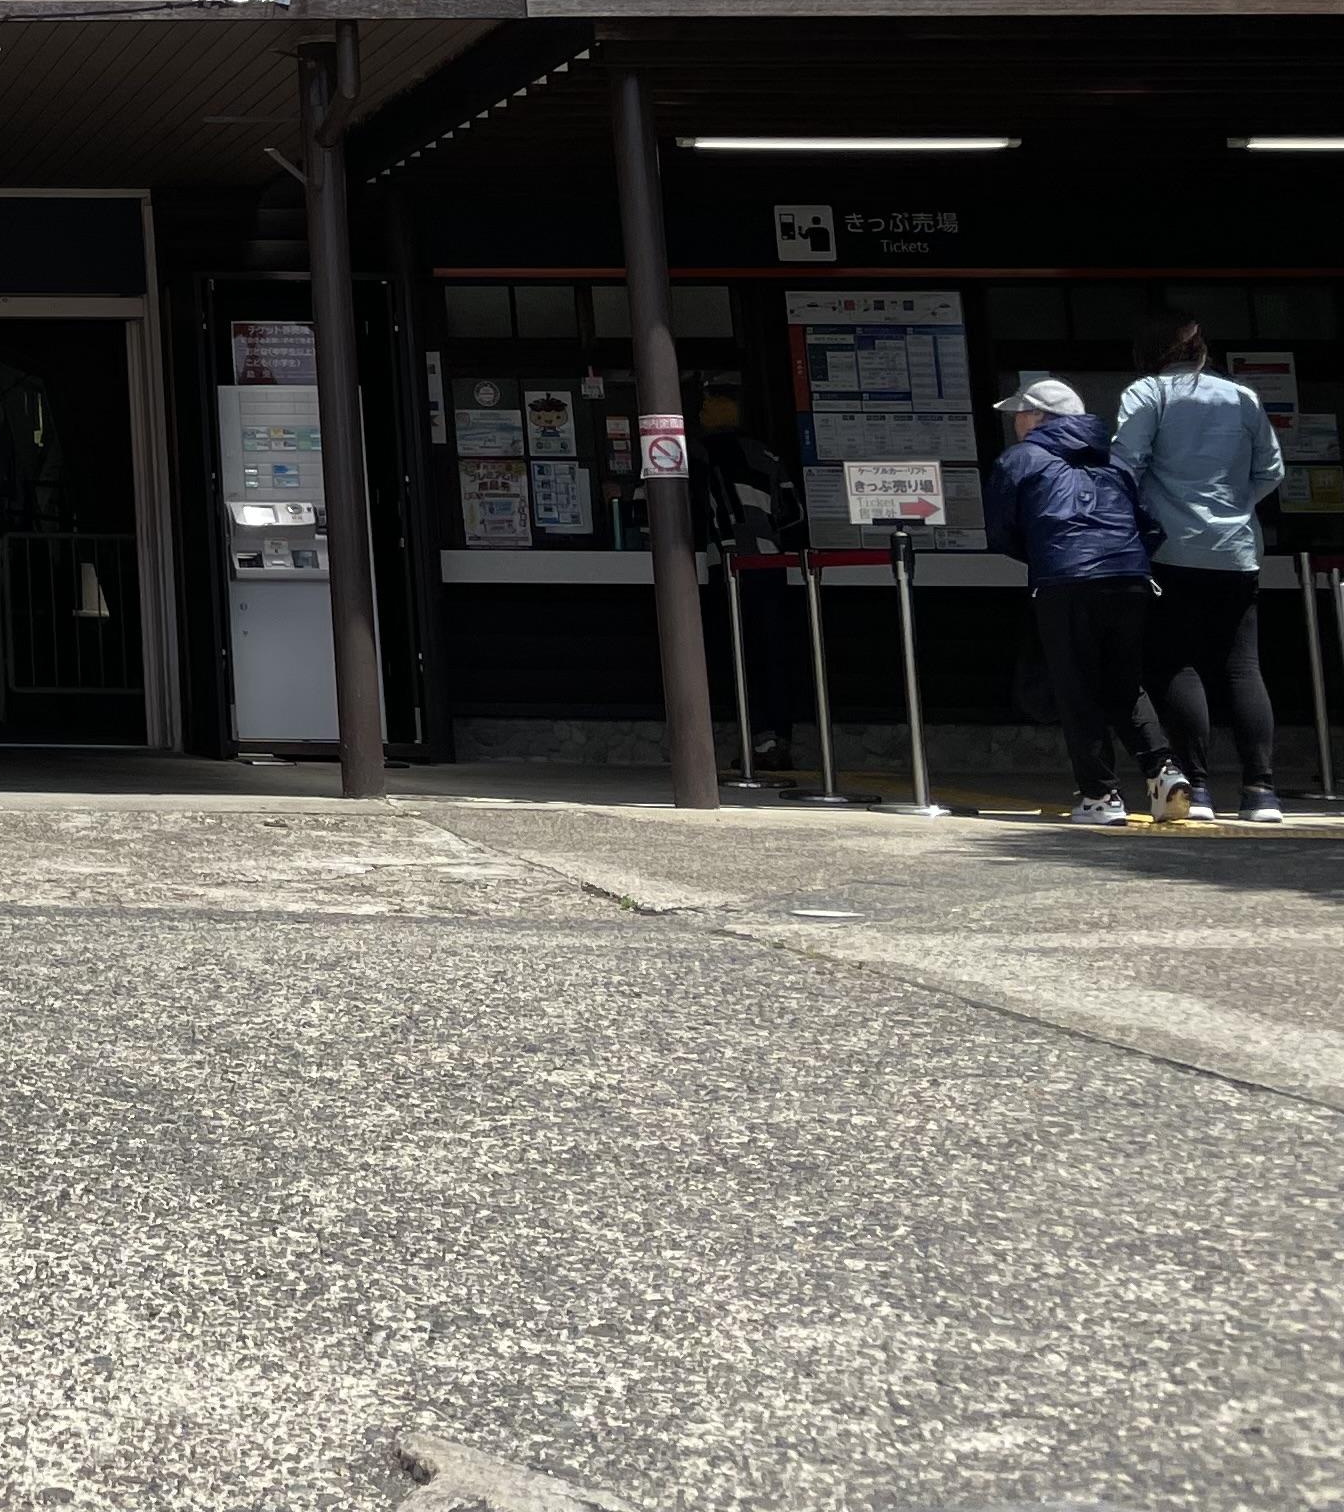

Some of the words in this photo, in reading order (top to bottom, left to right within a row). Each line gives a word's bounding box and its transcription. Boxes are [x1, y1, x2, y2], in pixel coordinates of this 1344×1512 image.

[844, 212, 960, 233] きっぷ売場
[880, 239, 930, 253] Tickets
[854, 479, 935, 494] きっぷ売り場
